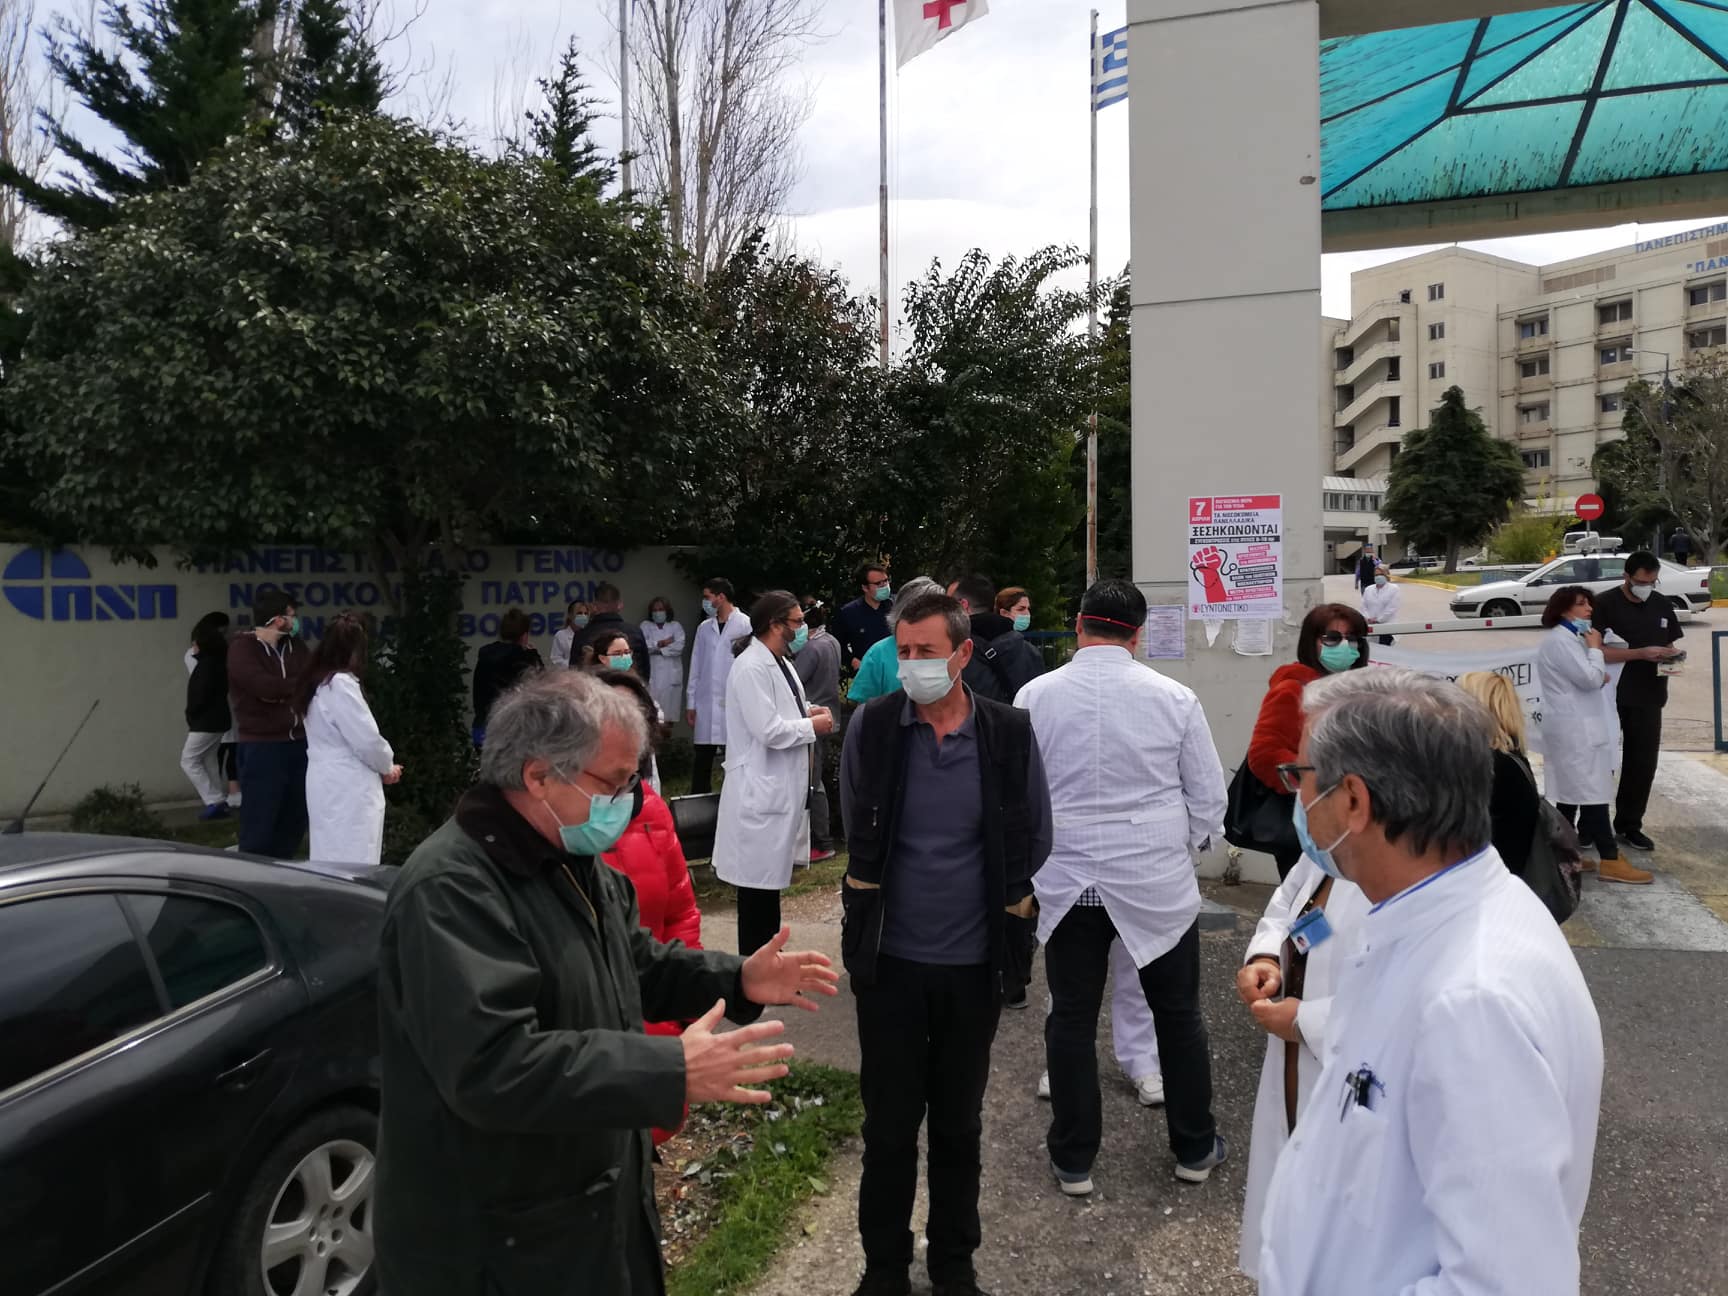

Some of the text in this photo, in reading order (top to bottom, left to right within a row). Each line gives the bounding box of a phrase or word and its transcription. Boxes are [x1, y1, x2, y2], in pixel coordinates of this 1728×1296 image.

[1195, 501, 1206, 516] 7
[1192, 524, 1278, 537] ΞΕΣΗΚΩΝΟΝΤΑΙ
[516, 548, 625, 574] ΓΕΝΙΚΟ
